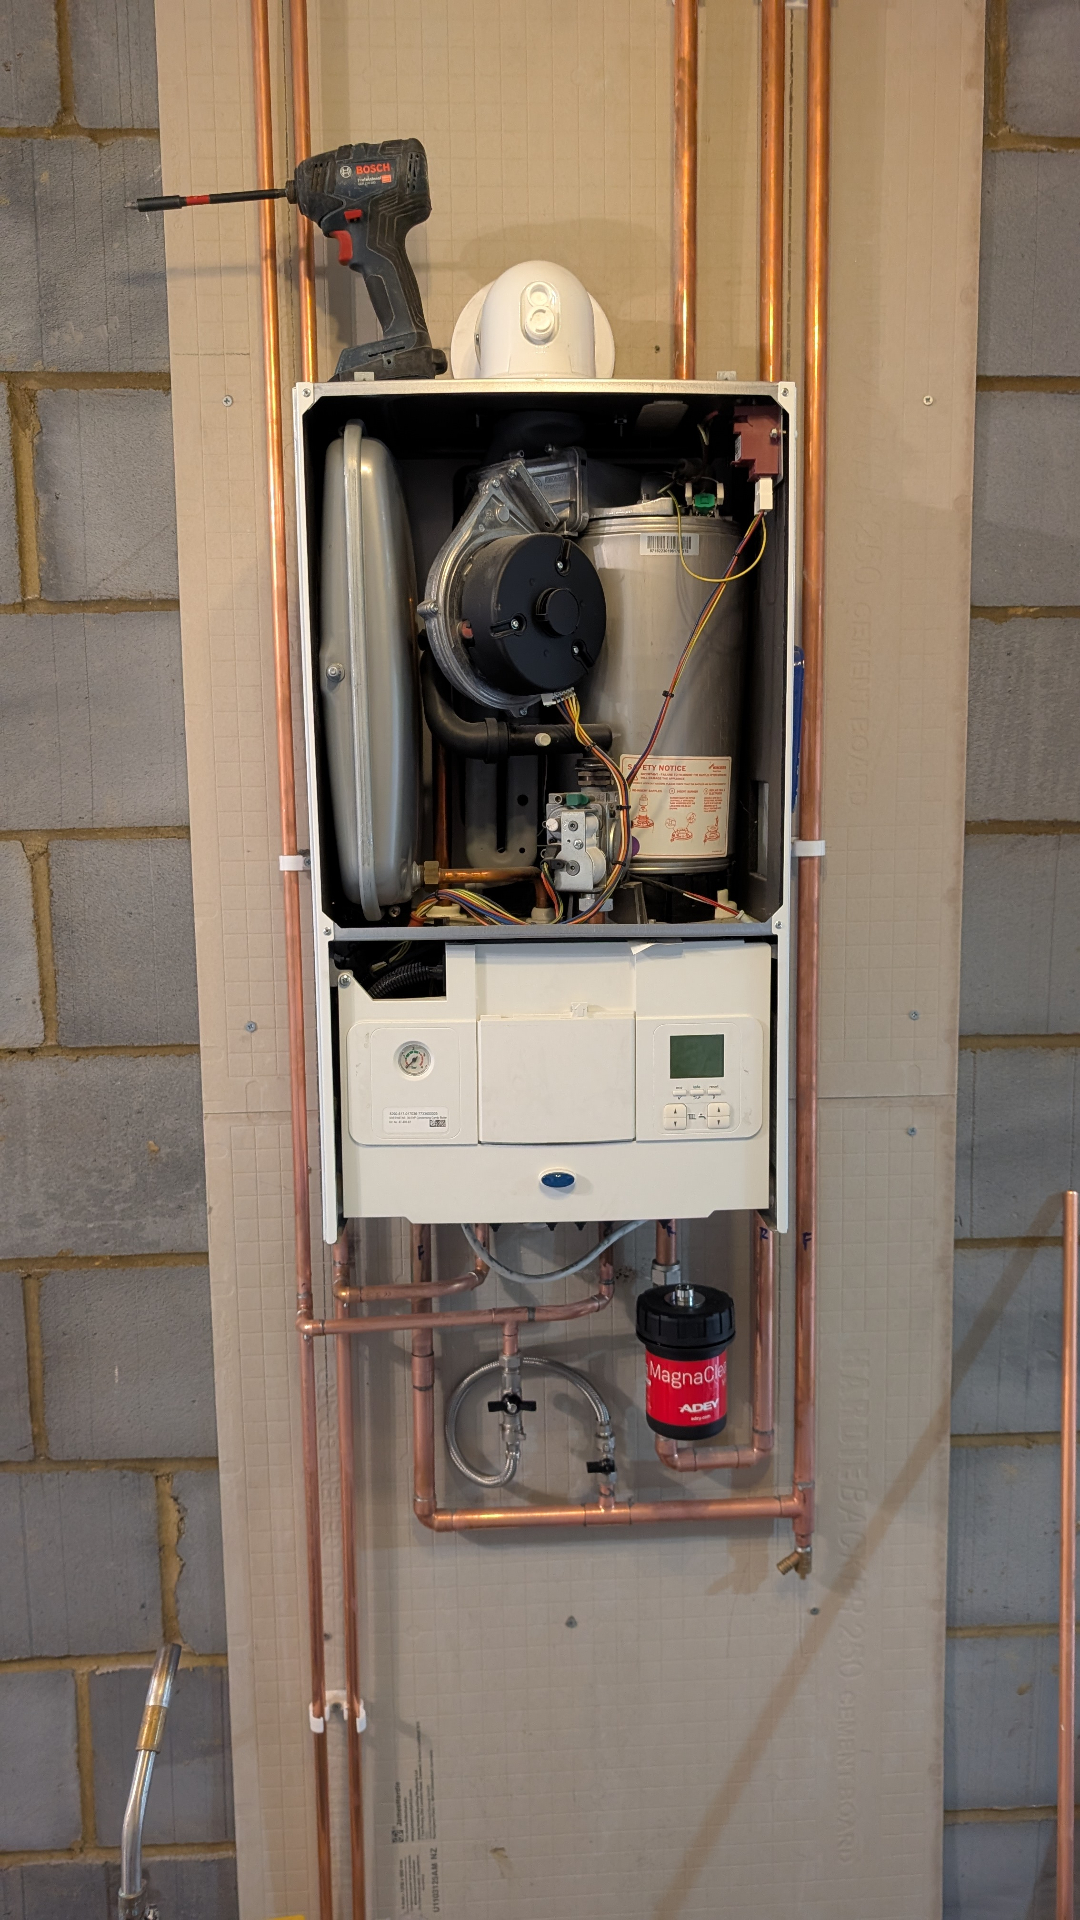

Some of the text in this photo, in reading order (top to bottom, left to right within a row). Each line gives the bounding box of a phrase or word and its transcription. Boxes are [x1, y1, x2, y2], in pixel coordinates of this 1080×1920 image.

[356, 163, 391, 175] BOSCH
[849, 602, 871, 707] CEMENT
[627, 763, 687, 772] SETY NOTICE
[847, 717, 871, 807] BOARD
[759, 1226, 769, 1241] R
[802, 1231, 812, 1252] F
[417, 1244, 425, 1260] F
[679, 1398, 719, 1413] ADEY
[836, 1347, 871, 1866] HARDIEBACKER 250 CEMENT BOARD
[394, 1782, 402, 1827] JamesHardie
[429, 1847, 438, 1860] NZ
